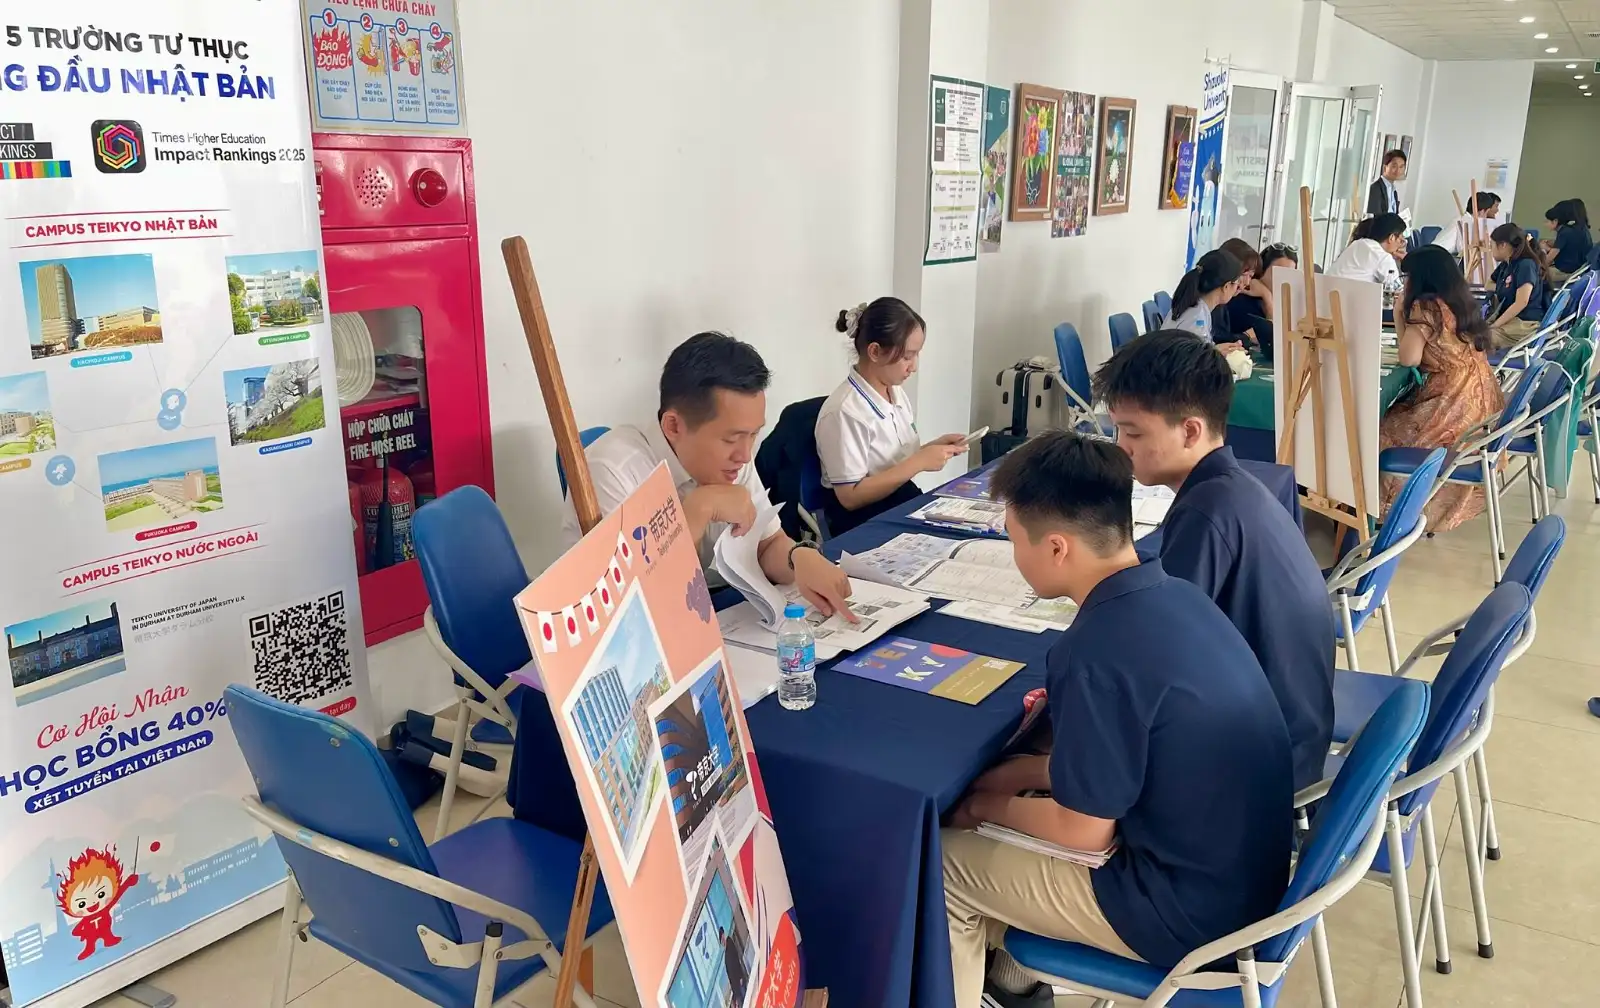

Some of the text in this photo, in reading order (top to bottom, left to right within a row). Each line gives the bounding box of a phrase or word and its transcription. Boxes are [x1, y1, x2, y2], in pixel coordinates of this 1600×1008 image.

[325, 12, 333, 24] 1
[412, 1, 436, 16] CHÁY
[363, 16, 371, 28] 2
[399, 21, 406, 33] 3
[431, 26, 440, 37] 4
[6, 25, 249, 63] 5 TRƯỜNG TƯ THỤC
[320, 39, 339, 51] BÁO
[0, 54, 276, 102] G ĐẦU NHẬT BẢN
[0, 124, 16, 139] CT
[152, 132, 266, 146] Times Higher Education
[154, 147, 306, 164] Impact Rankings 2025
[25, 214, 218, 238] CAMPUS TEIKYO NHẬT BẢN
[103, 354, 126, 362] CAMPUS
[347, 408, 414, 440] HỘP CHỮA CHÁY
[396, 432, 417, 451] REEL
[648, 494, 677, 543] 帝京大学
[144, 523, 190, 538] FUKUOKA CAMPUS
[62, 531, 259, 588] CAMPUS TEIKYO NƯỚC NGOÀI
[131, 613, 153, 624] TEIKYO
[153, 604, 188, 617] UNIVERSITY
[198, 596, 218, 606] JAPAN
[139, 616, 166, 629] DURHAM
[176, 607, 202, 619] DURHAM
[202, 598, 235, 611] UNIVERSITY
[36, 684, 190, 749] Cơ Hội Nhận
[0, 698, 227, 797] HỌC BỔNG 40%
[32, 736, 208, 811] XÉT TUYỂN TẠI VIỆT NAM
